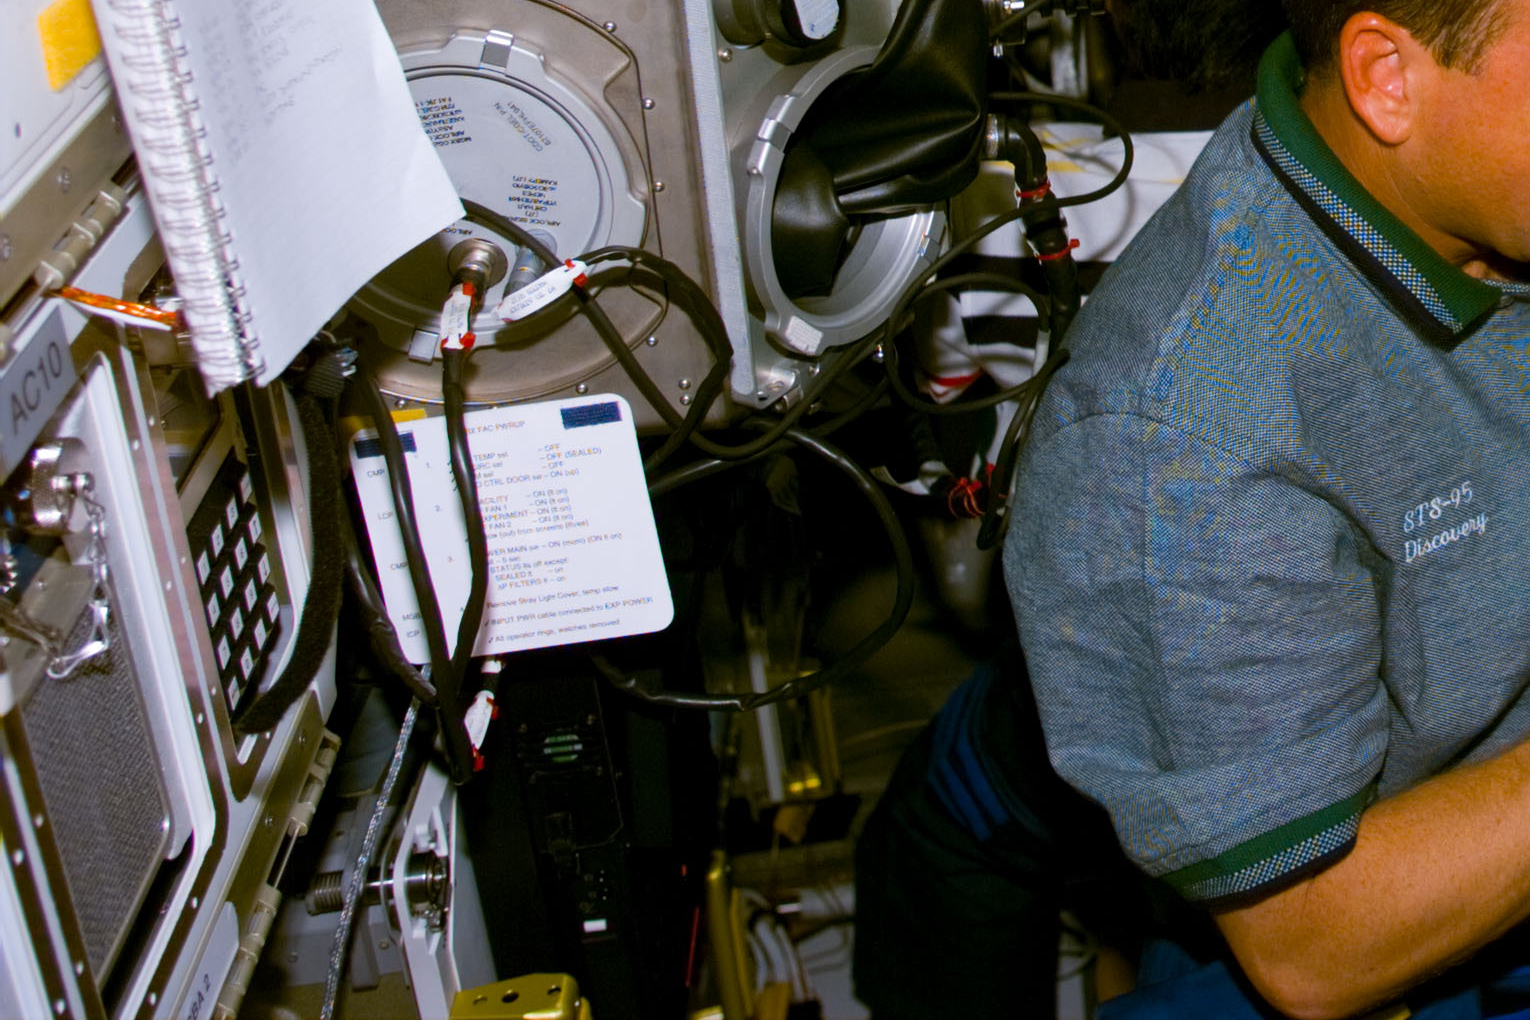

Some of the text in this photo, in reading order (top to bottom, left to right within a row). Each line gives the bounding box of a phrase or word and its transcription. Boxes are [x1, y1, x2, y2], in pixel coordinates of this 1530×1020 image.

[9, 341, 62, 434] AC10
[543, 443, 561, 452] OFF
[546, 452, 562, 461] OFF
[547, 460, 565, 469] OFF
[505, 474, 530, 484] DOOR
[549, 469, 563, 478] ON
[532, 489, 546, 498] ON
[534, 498, 547, 506] ON
[536, 506, 550, 515] ON
[1404, 481, 1473, 533] STS-95
[538, 515, 551, 524] ON
[1405, 512, 1489, 563] Discovery
[547, 539, 561, 548] ON
[622, 596, 653, 607] POWER
[203, 973, 211, 992] 2
